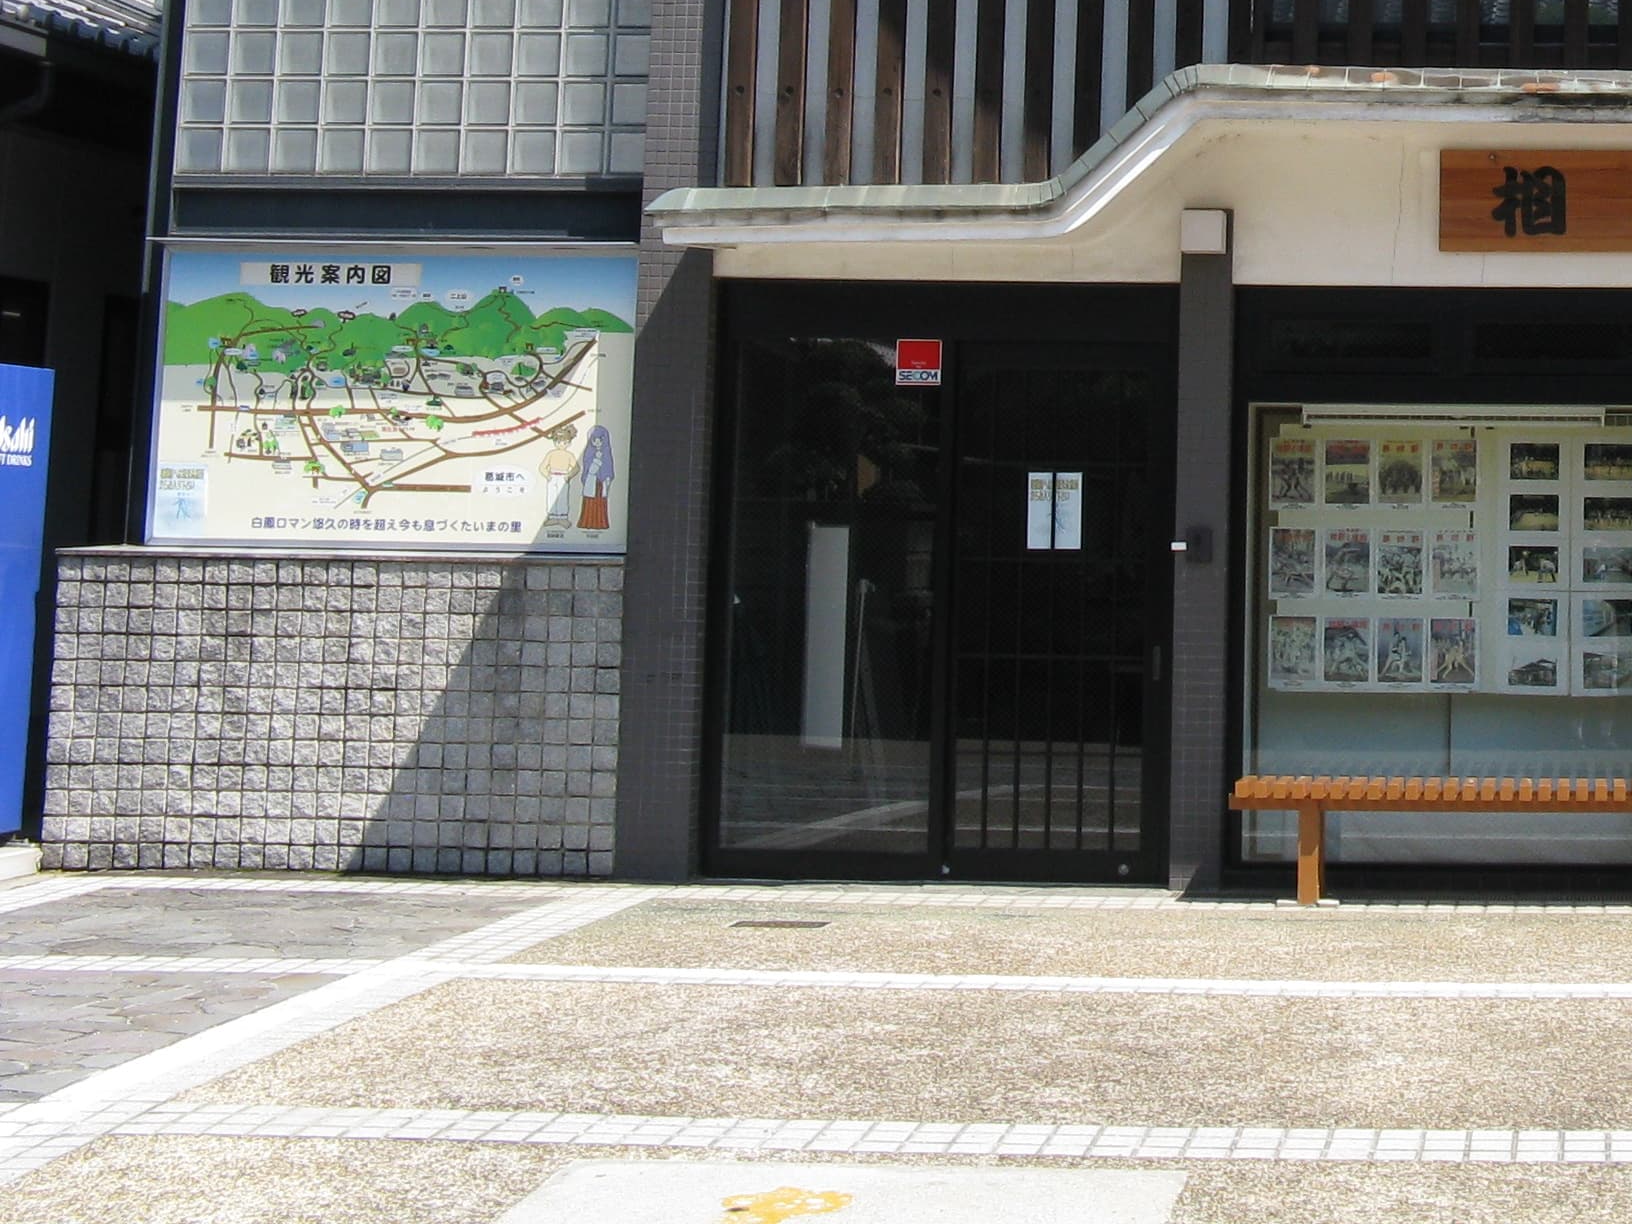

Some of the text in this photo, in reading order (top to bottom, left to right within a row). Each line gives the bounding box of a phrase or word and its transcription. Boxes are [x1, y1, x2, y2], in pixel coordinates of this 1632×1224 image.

[269, 263, 392, 285] 観光案内図
[898, 371, 938, 381] SECOM
